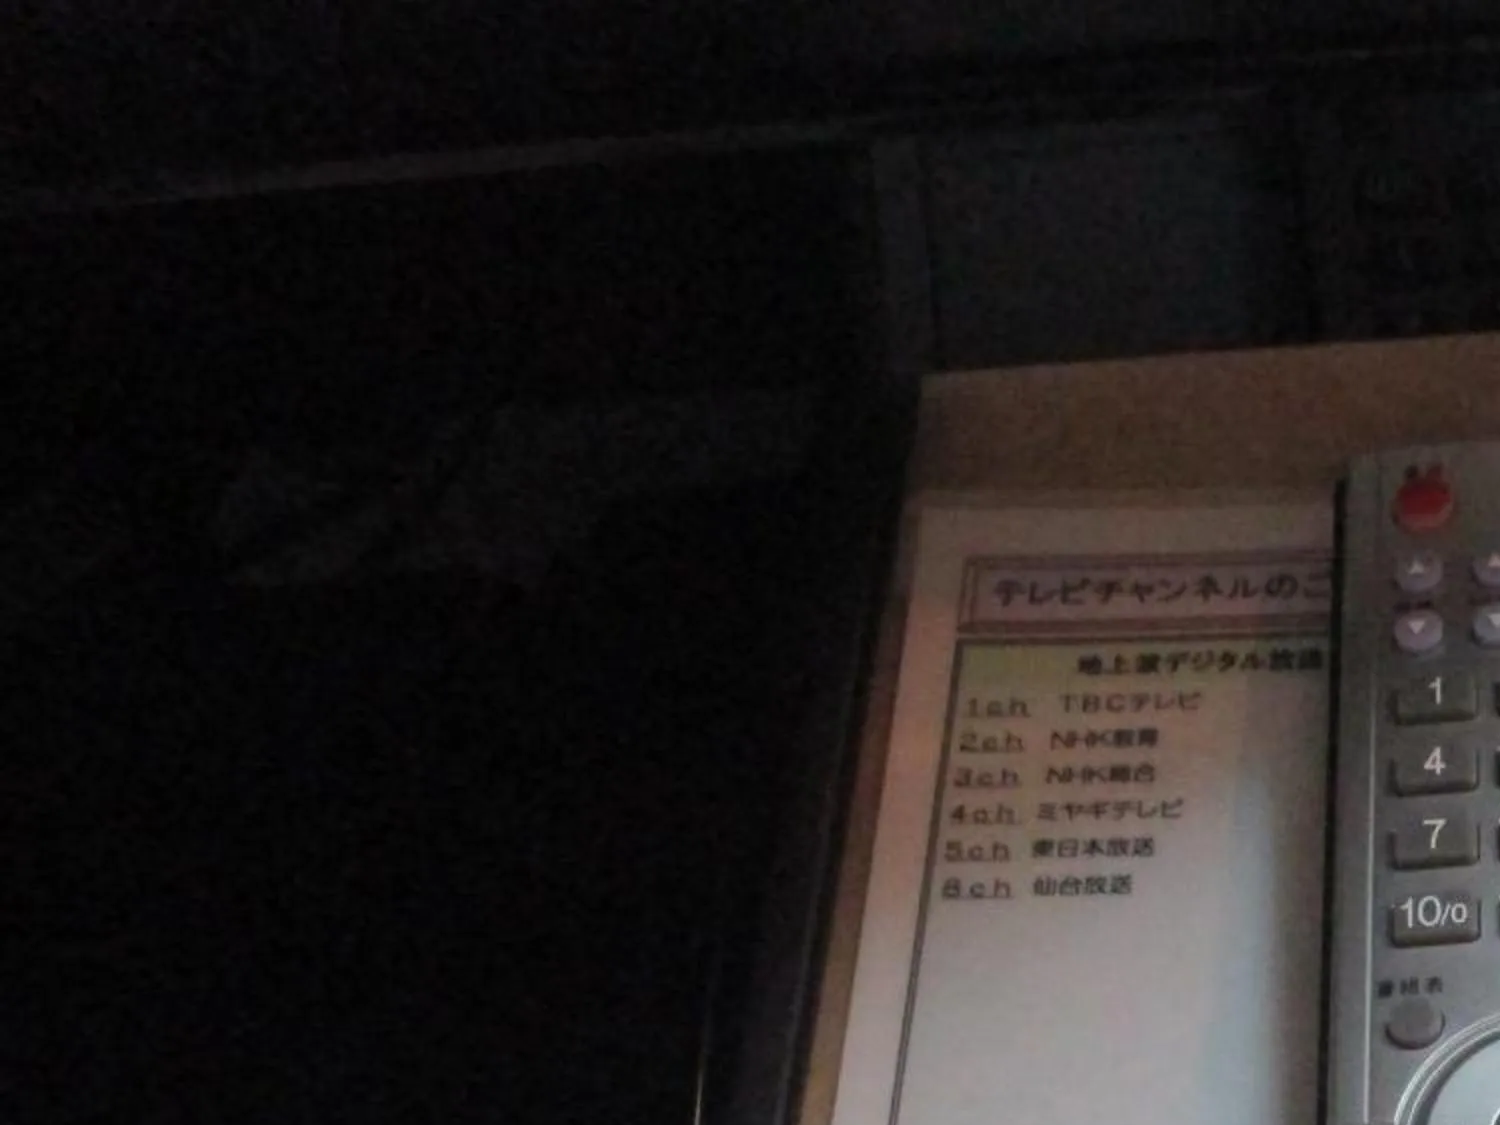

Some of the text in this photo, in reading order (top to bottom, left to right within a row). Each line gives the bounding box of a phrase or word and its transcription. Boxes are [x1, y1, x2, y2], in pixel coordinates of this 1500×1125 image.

[1430, 677, 1441, 704] 1
[1424, 746, 1446, 774] 4
[1422, 819, 1446, 849] 7
[1031, 838, 1156, 860] 東日本放送
[1034, 874, 1134, 897] 仙台放送
[1400, 896, 1468, 929] 10/0
